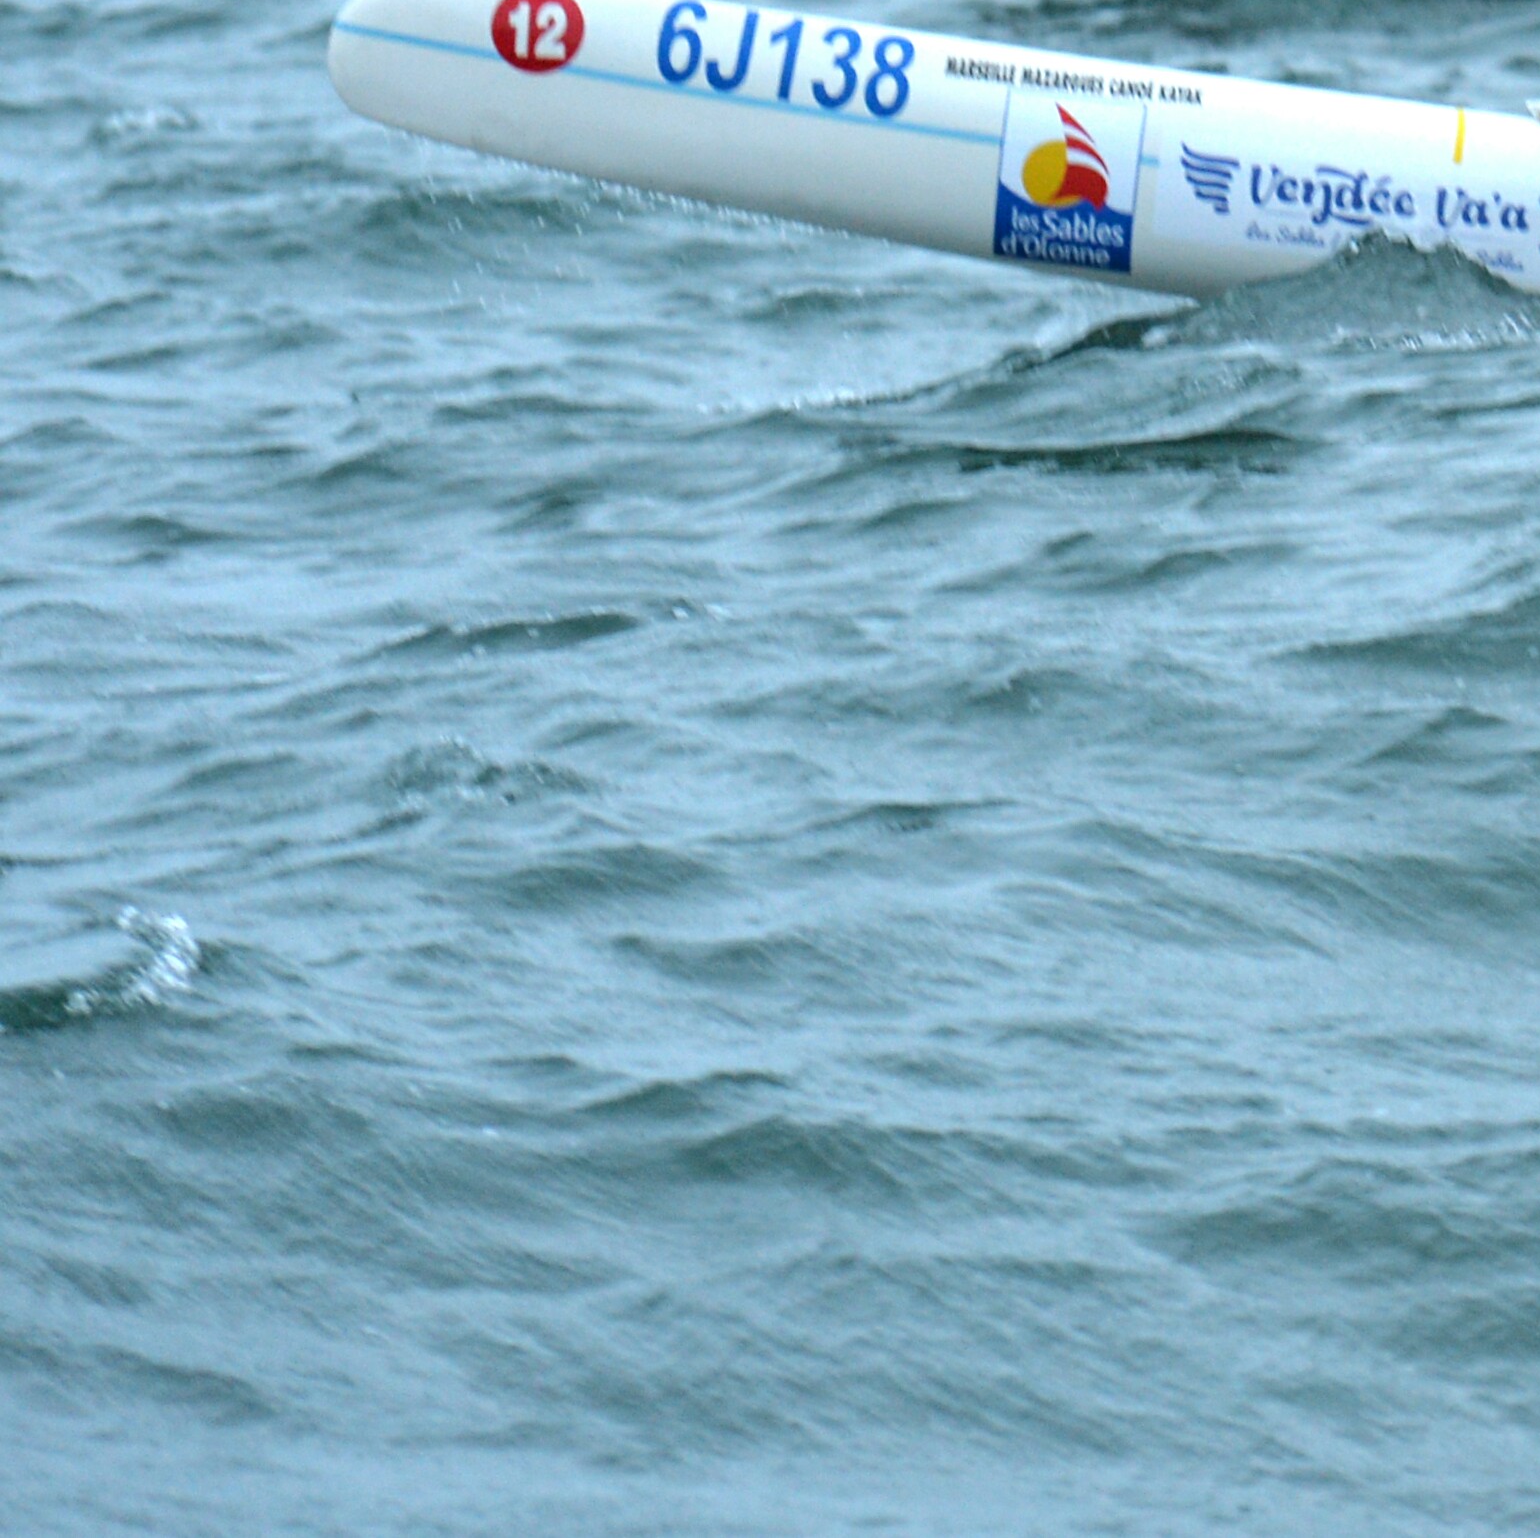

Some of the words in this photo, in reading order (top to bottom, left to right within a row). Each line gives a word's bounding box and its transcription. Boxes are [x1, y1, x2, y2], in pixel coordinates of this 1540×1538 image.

[508, 0, 568, 60] 12
[945, 56, 1016, 85] MARSEILLE
[1158, 85, 1202, 105] KAYAK
[1250, 164, 1415, 225] Vendée
[1436, 185, 1529, 231] Va'a
[1001, 230, 1111, 264] d'Olonne
[1012, 206, 1039, 231] les
[1042, 209, 1125, 248] Sables
